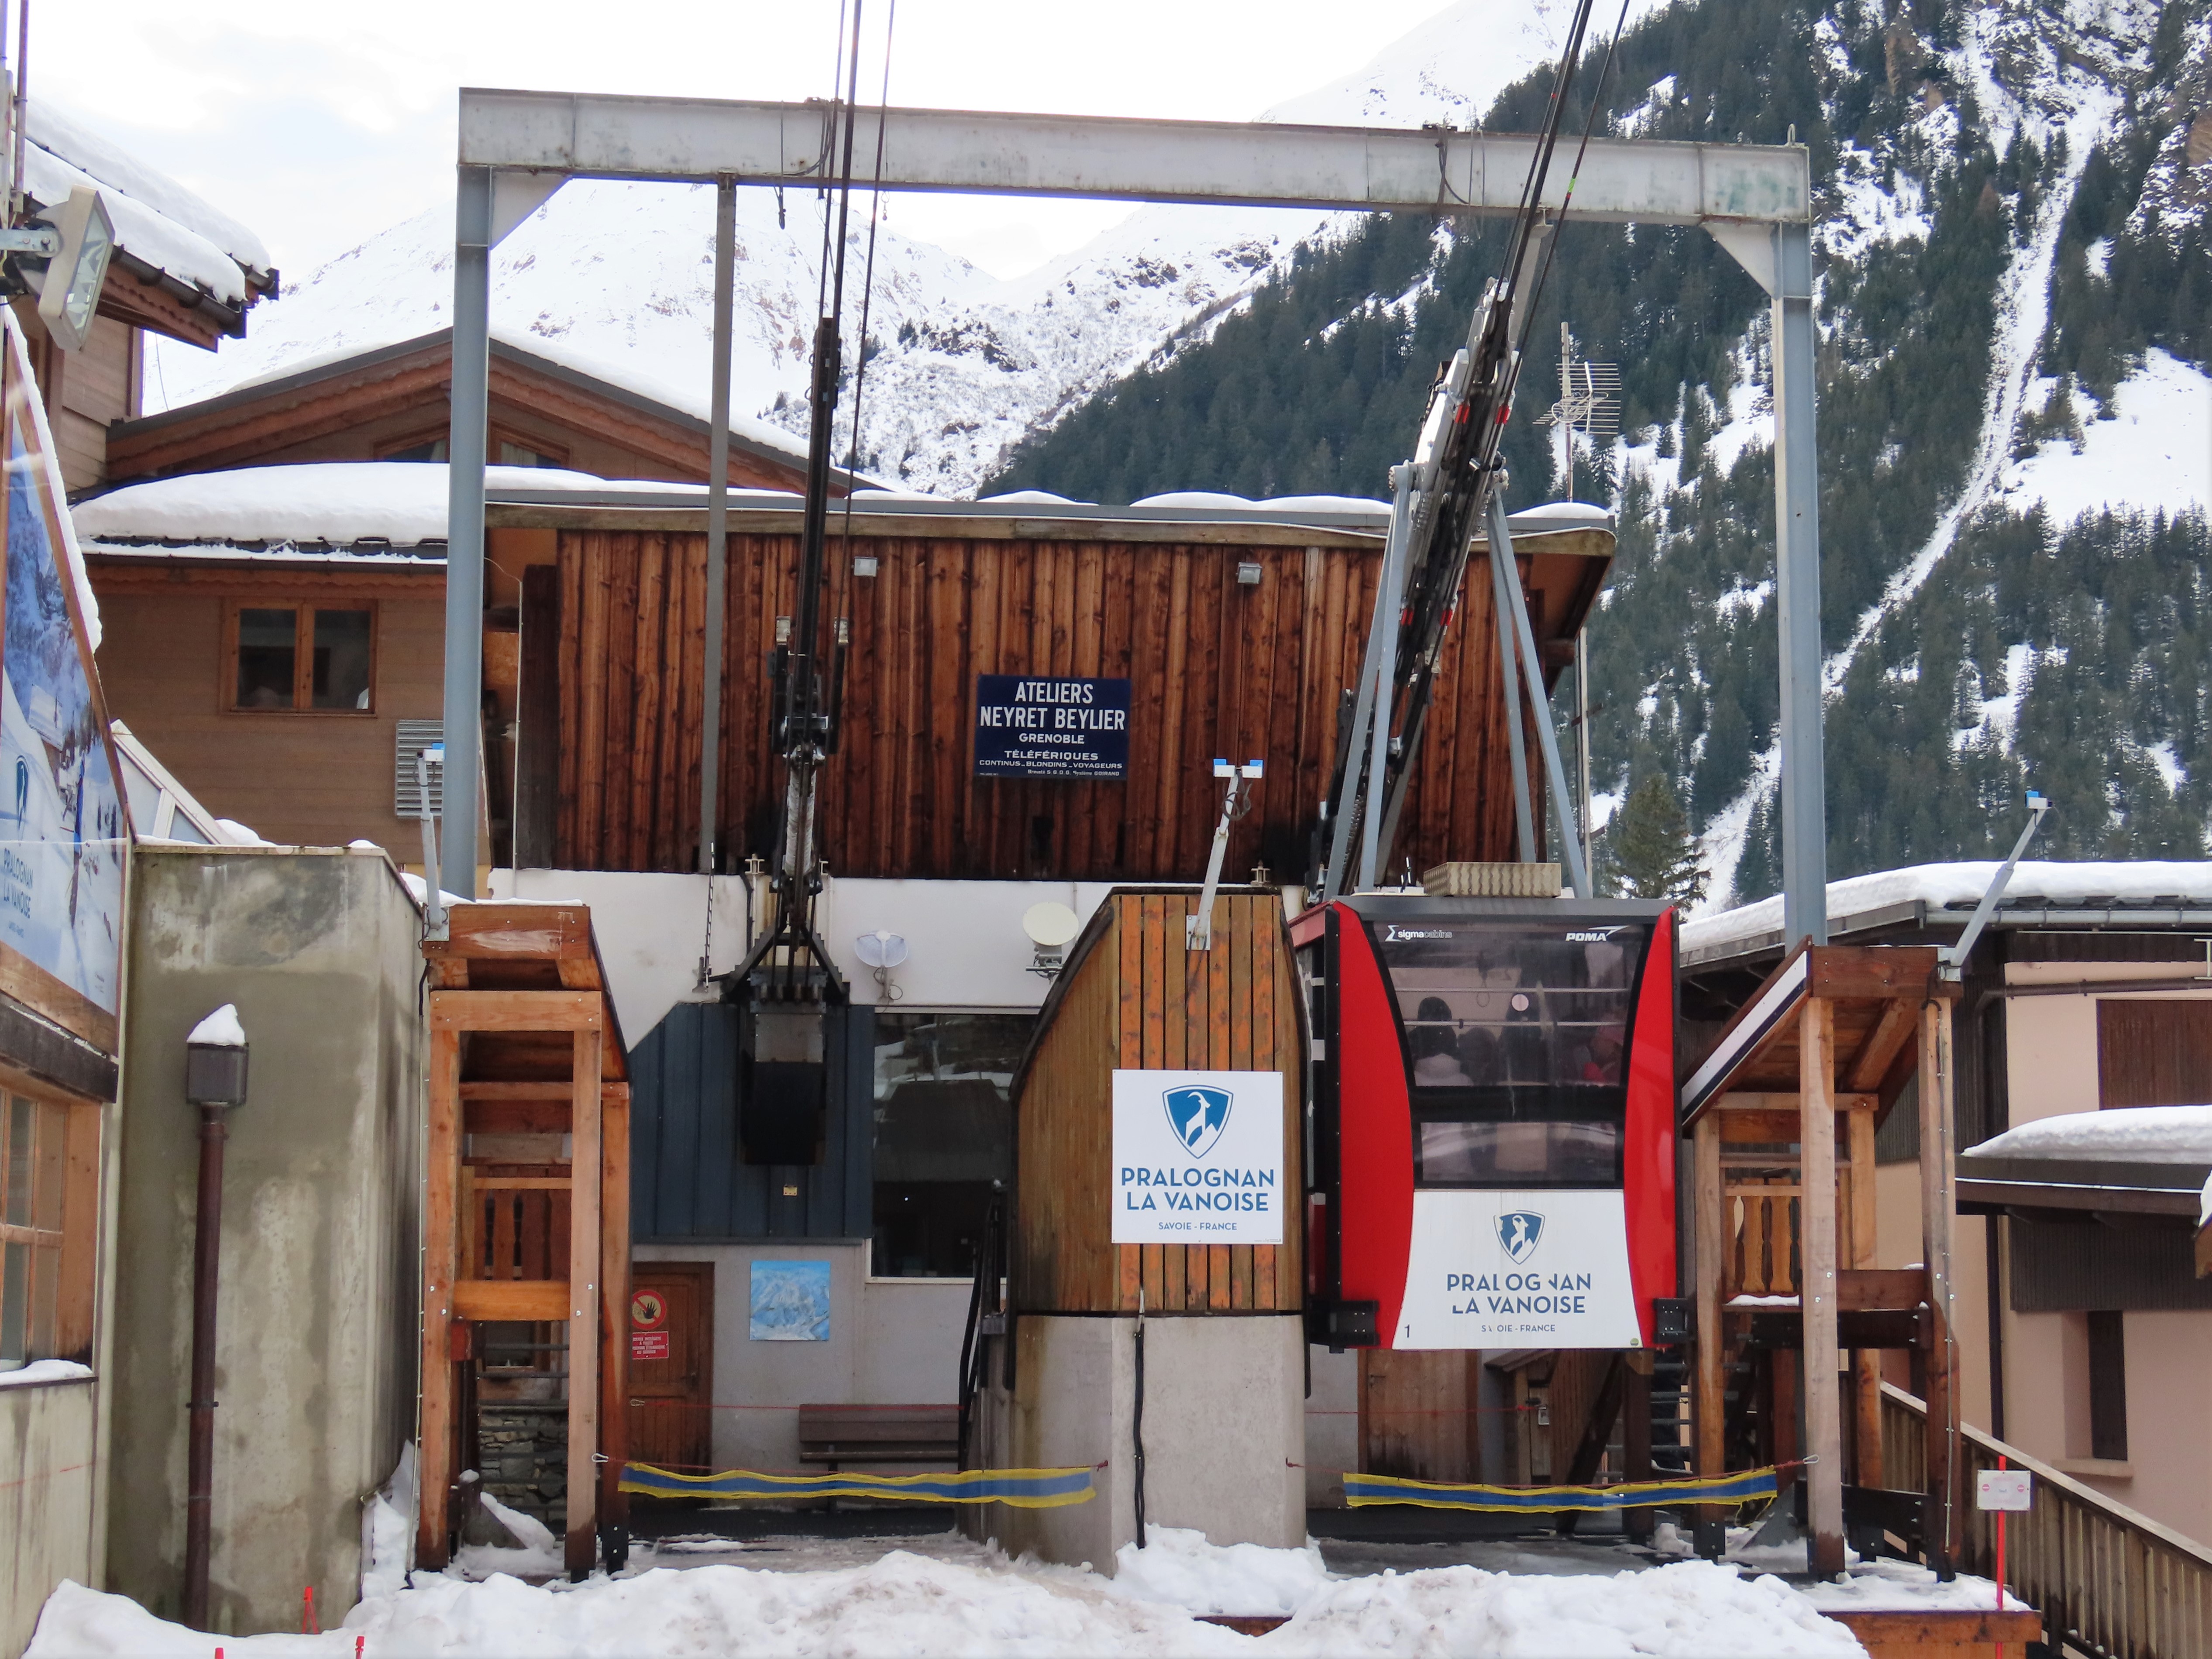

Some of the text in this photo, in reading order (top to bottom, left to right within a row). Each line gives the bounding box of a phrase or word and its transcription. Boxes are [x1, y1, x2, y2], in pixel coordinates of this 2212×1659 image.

[1015, 682, 1093, 704] ATELIERS
[980, 706, 1125, 730] NEYRET BEYLIER
[1019, 733, 1085, 744] GRENOBLE
[1004, 749, 1098, 761] TÉLÉFÉRIQUES
[1397, 929, 1453, 940] sigmacabins
[1565, 933, 1607, 941] POMA
[1121, 1168, 1274, 1187] PRALOGNAN
[1127, 1192, 1269, 1212] LA VANOISE
[1487, 1296, 1585, 1314] VANOISE
[1404, 1325, 1410, 1338] 1
